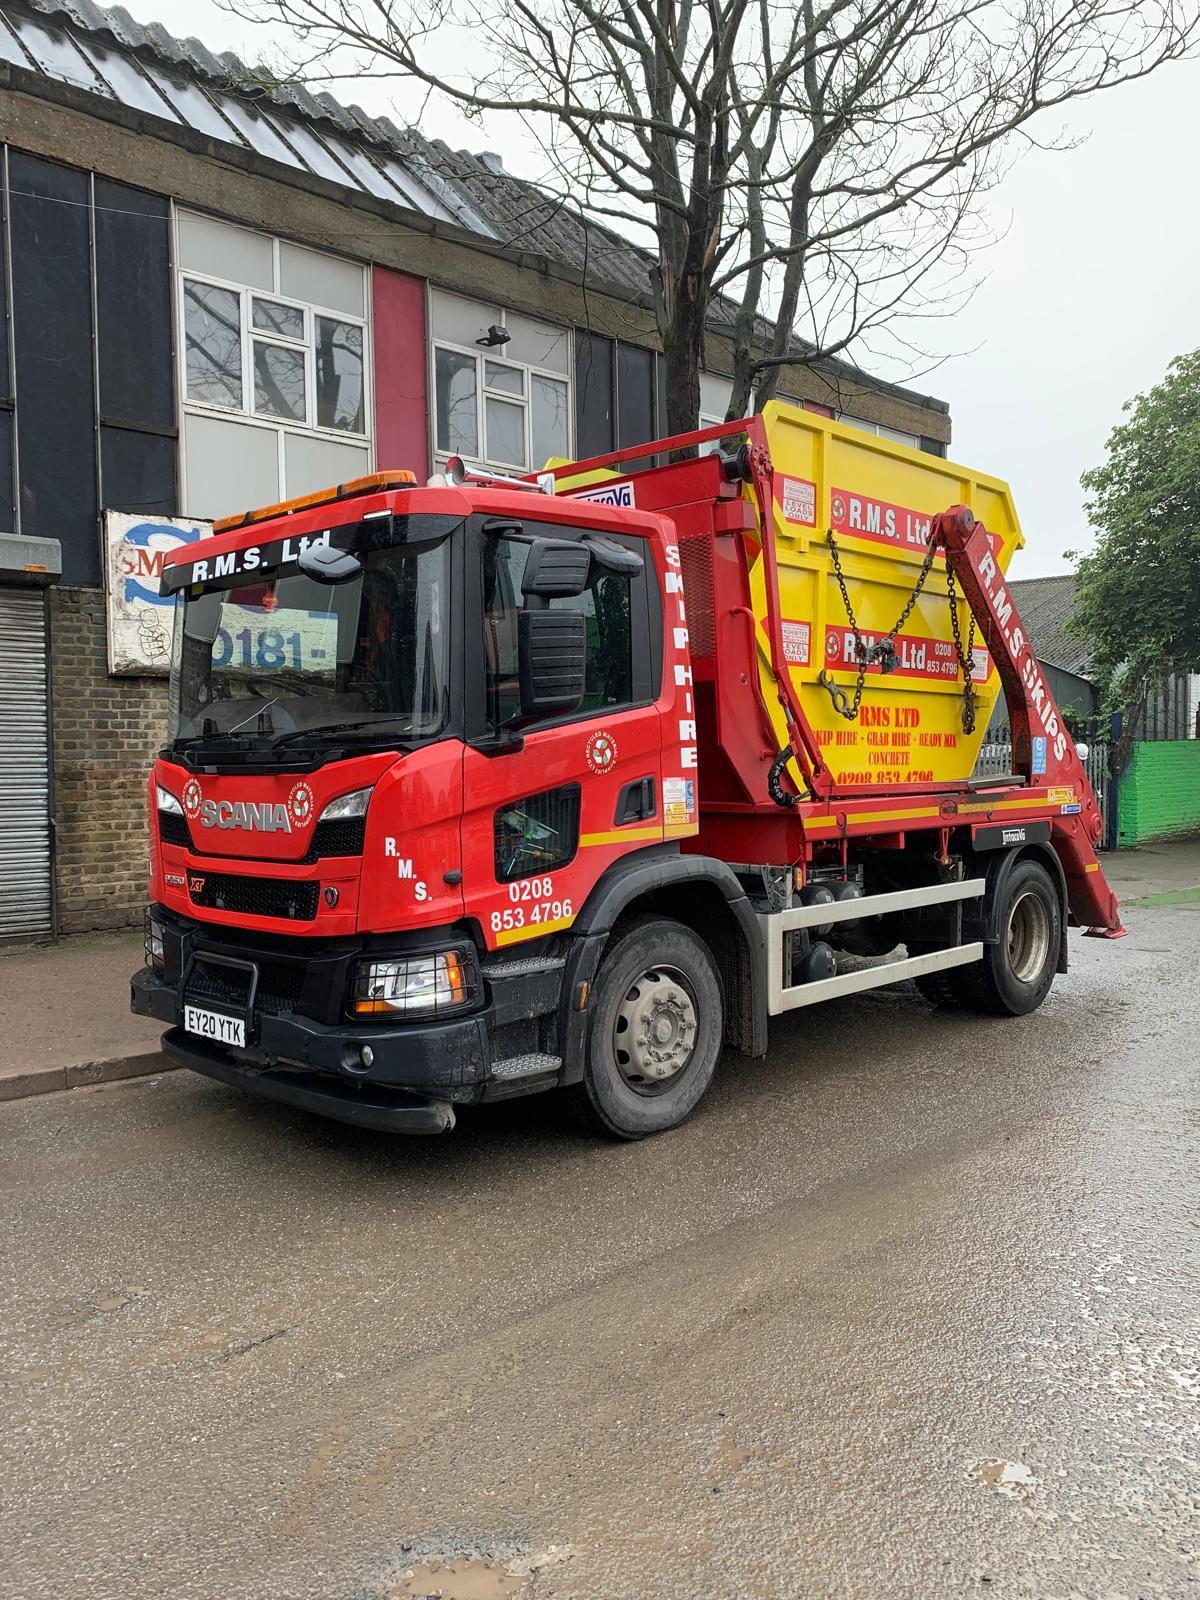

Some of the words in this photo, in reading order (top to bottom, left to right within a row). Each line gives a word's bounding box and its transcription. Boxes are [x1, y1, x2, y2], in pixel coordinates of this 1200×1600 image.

[785, 505, 813, 516] LOADS
[786, 500, 813, 511] LEVEL
[788, 512, 809, 521] ONLY
[850, 498, 900, 540] R.M.S.
[191, 547, 268, 583] R.M.S.
[783, 643, 807, 651] EVEL
[784, 648, 808, 656] OADS
[901, 640, 926, 670] Ltd
[935, 643, 952, 656] 0208
[926, 660, 940, 673] 853
[941, 662, 957, 675] 4796
[673, 665, 698, 769] HIRE
[859, 705, 890, 727] RMS
[894, 707, 920, 728] LTD
[836, 731, 857, 746] HIRE
[892, 732, 911, 747] HIRE
[919, 733, 941, 748] READY
[868, 752, 910, 765] CONCRETE
[200, 800, 292, 834] SCANIA
[384, 837, 400, 857] R.
[398, 858, 417, 879] M.
[190, 877, 206, 892] XT
[414, 881, 433, 902] S.
[508, 877, 553, 903] 0208
[490, 907, 525, 932] 853
[530, 898, 573, 924] 4796
[188, 1009, 216, 1035] EY20
[218, 1017, 241, 1043] YTK
